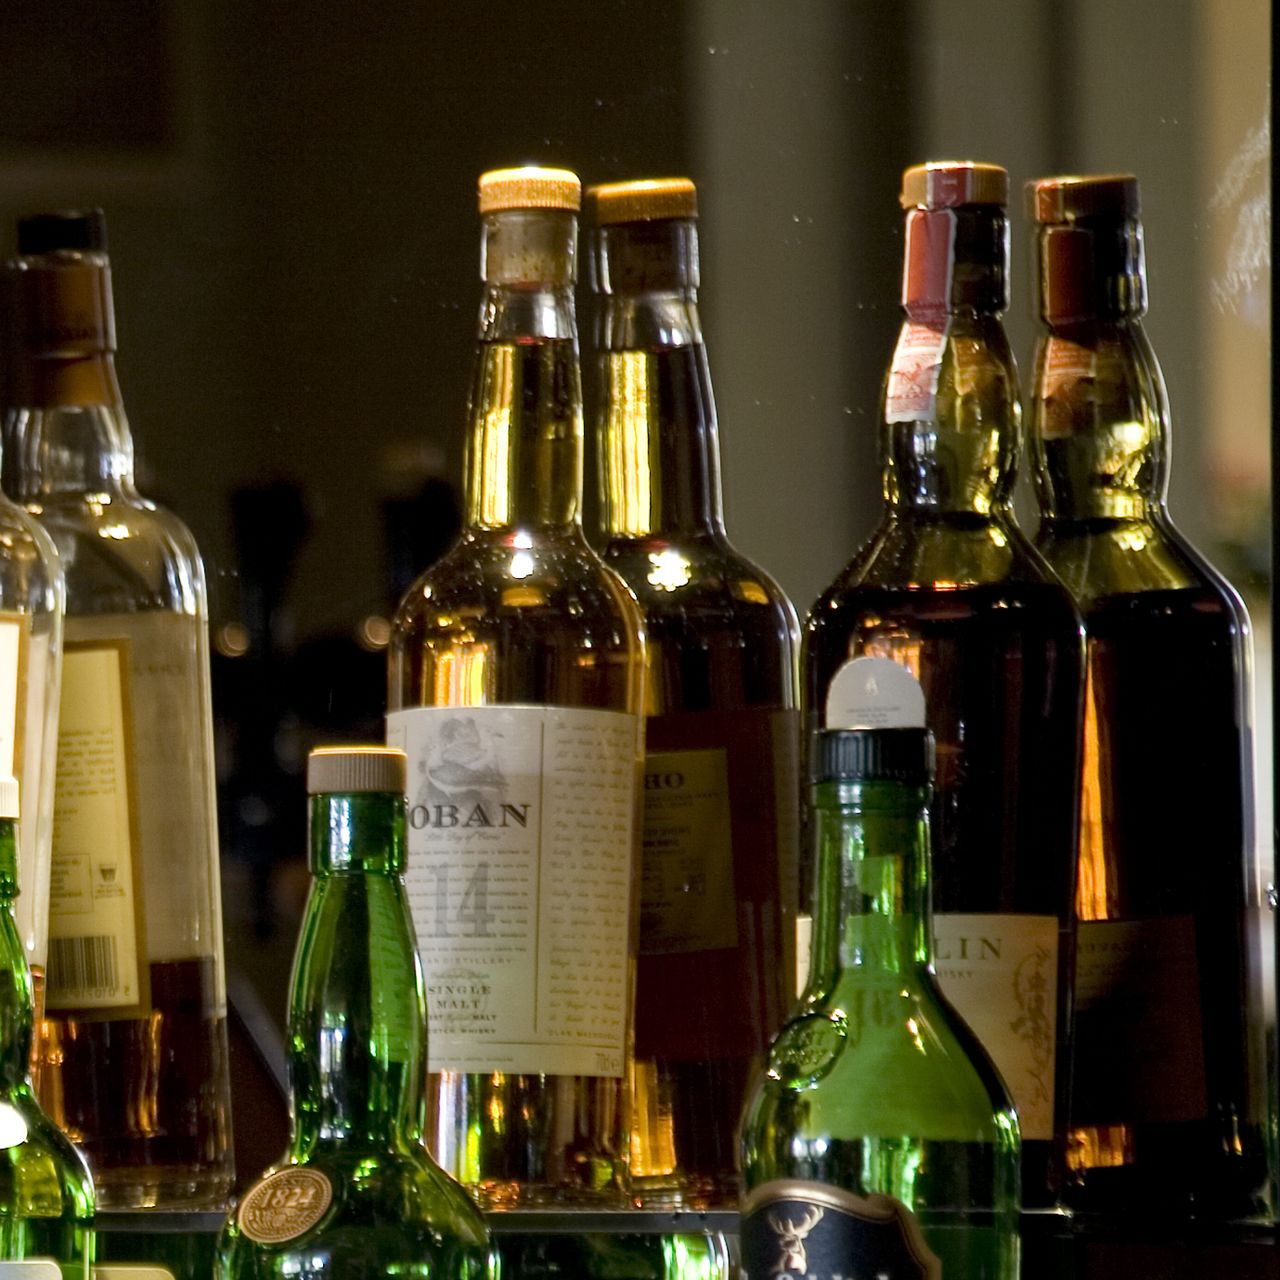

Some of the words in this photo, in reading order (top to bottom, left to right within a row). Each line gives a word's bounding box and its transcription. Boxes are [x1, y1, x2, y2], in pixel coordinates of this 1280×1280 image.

[409, 803, 532, 830] OBAN
[428, 985, 493, 995] SINGLE
[437, 1000, 482, 1010] MALT
